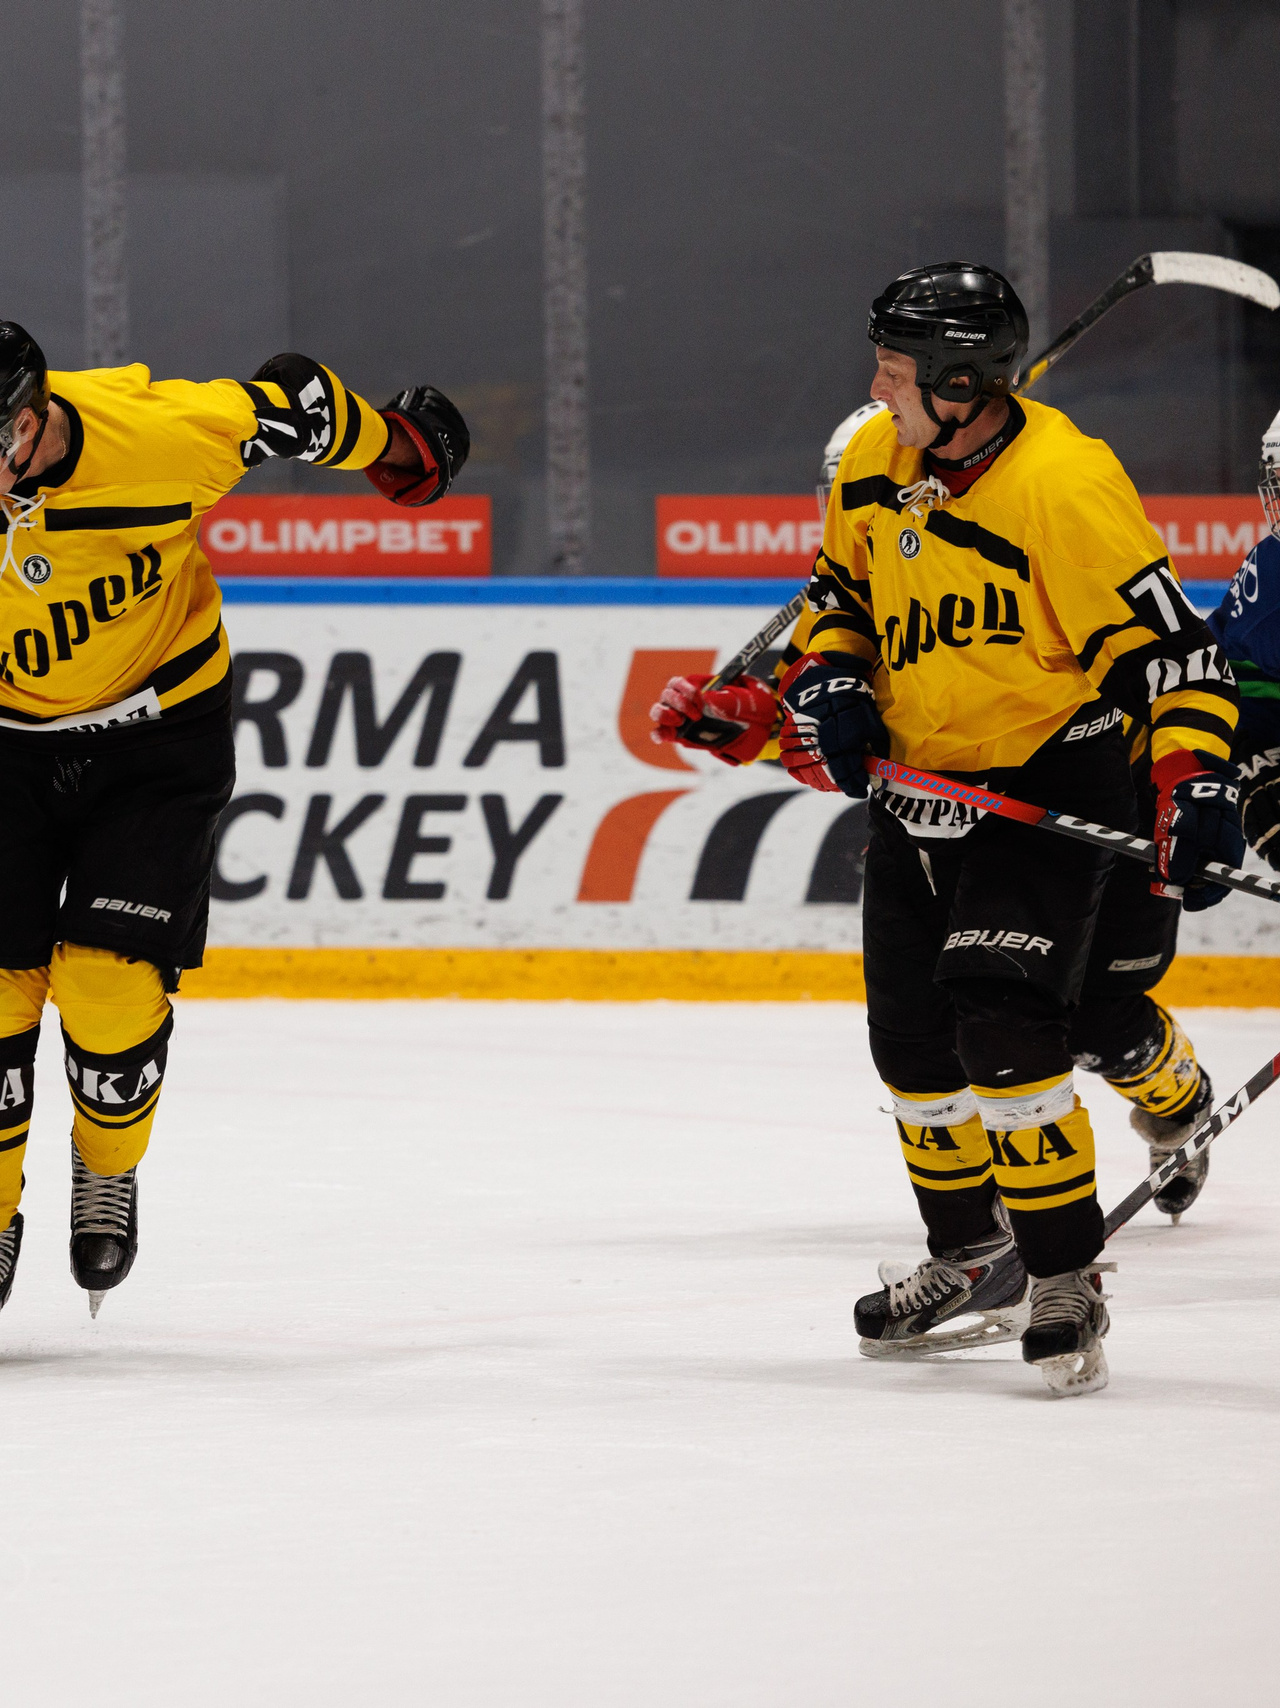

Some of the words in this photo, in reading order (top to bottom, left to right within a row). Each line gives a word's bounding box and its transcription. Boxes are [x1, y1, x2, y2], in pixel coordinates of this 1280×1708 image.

[945, 330, 987, 341] BAUER
[963, 436, 1004, 469] BAUER
[208, 519, 482, 556] OLIMPBET
[231, 651, 566, 769] RMA
[210, 793, 564, 903] CKEY
[90, 897, 172, 925] BAUER
[943, 929, 1055, 956] BAUER
[1146, 1086, 1250, 1193] CCM
